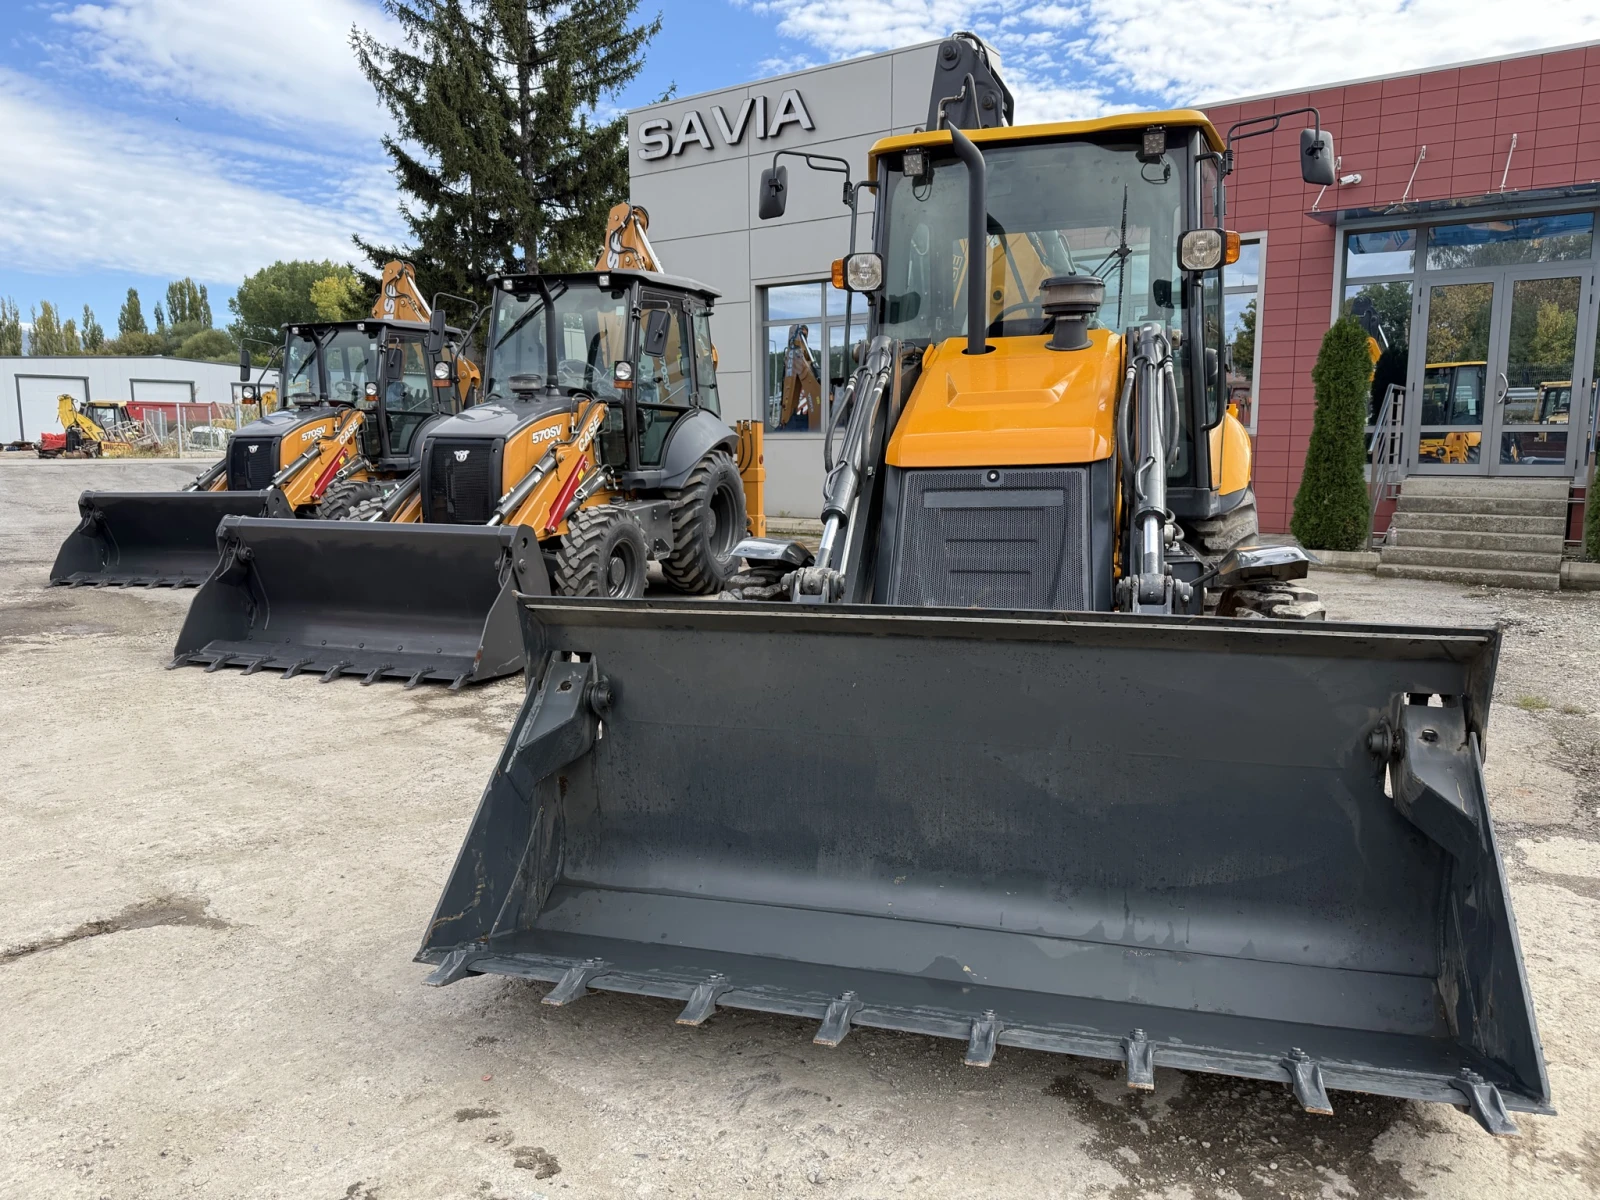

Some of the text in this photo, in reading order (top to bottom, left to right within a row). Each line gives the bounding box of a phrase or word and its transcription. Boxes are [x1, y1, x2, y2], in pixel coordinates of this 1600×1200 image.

[637, 88, 816, 161] SAVIA
[301, 424, 327, 442] 570SV
[339, 419, 360, 445] CASE
[532, 423, 563, 445] 570SV
[578, 414, 600, 453] CASE
